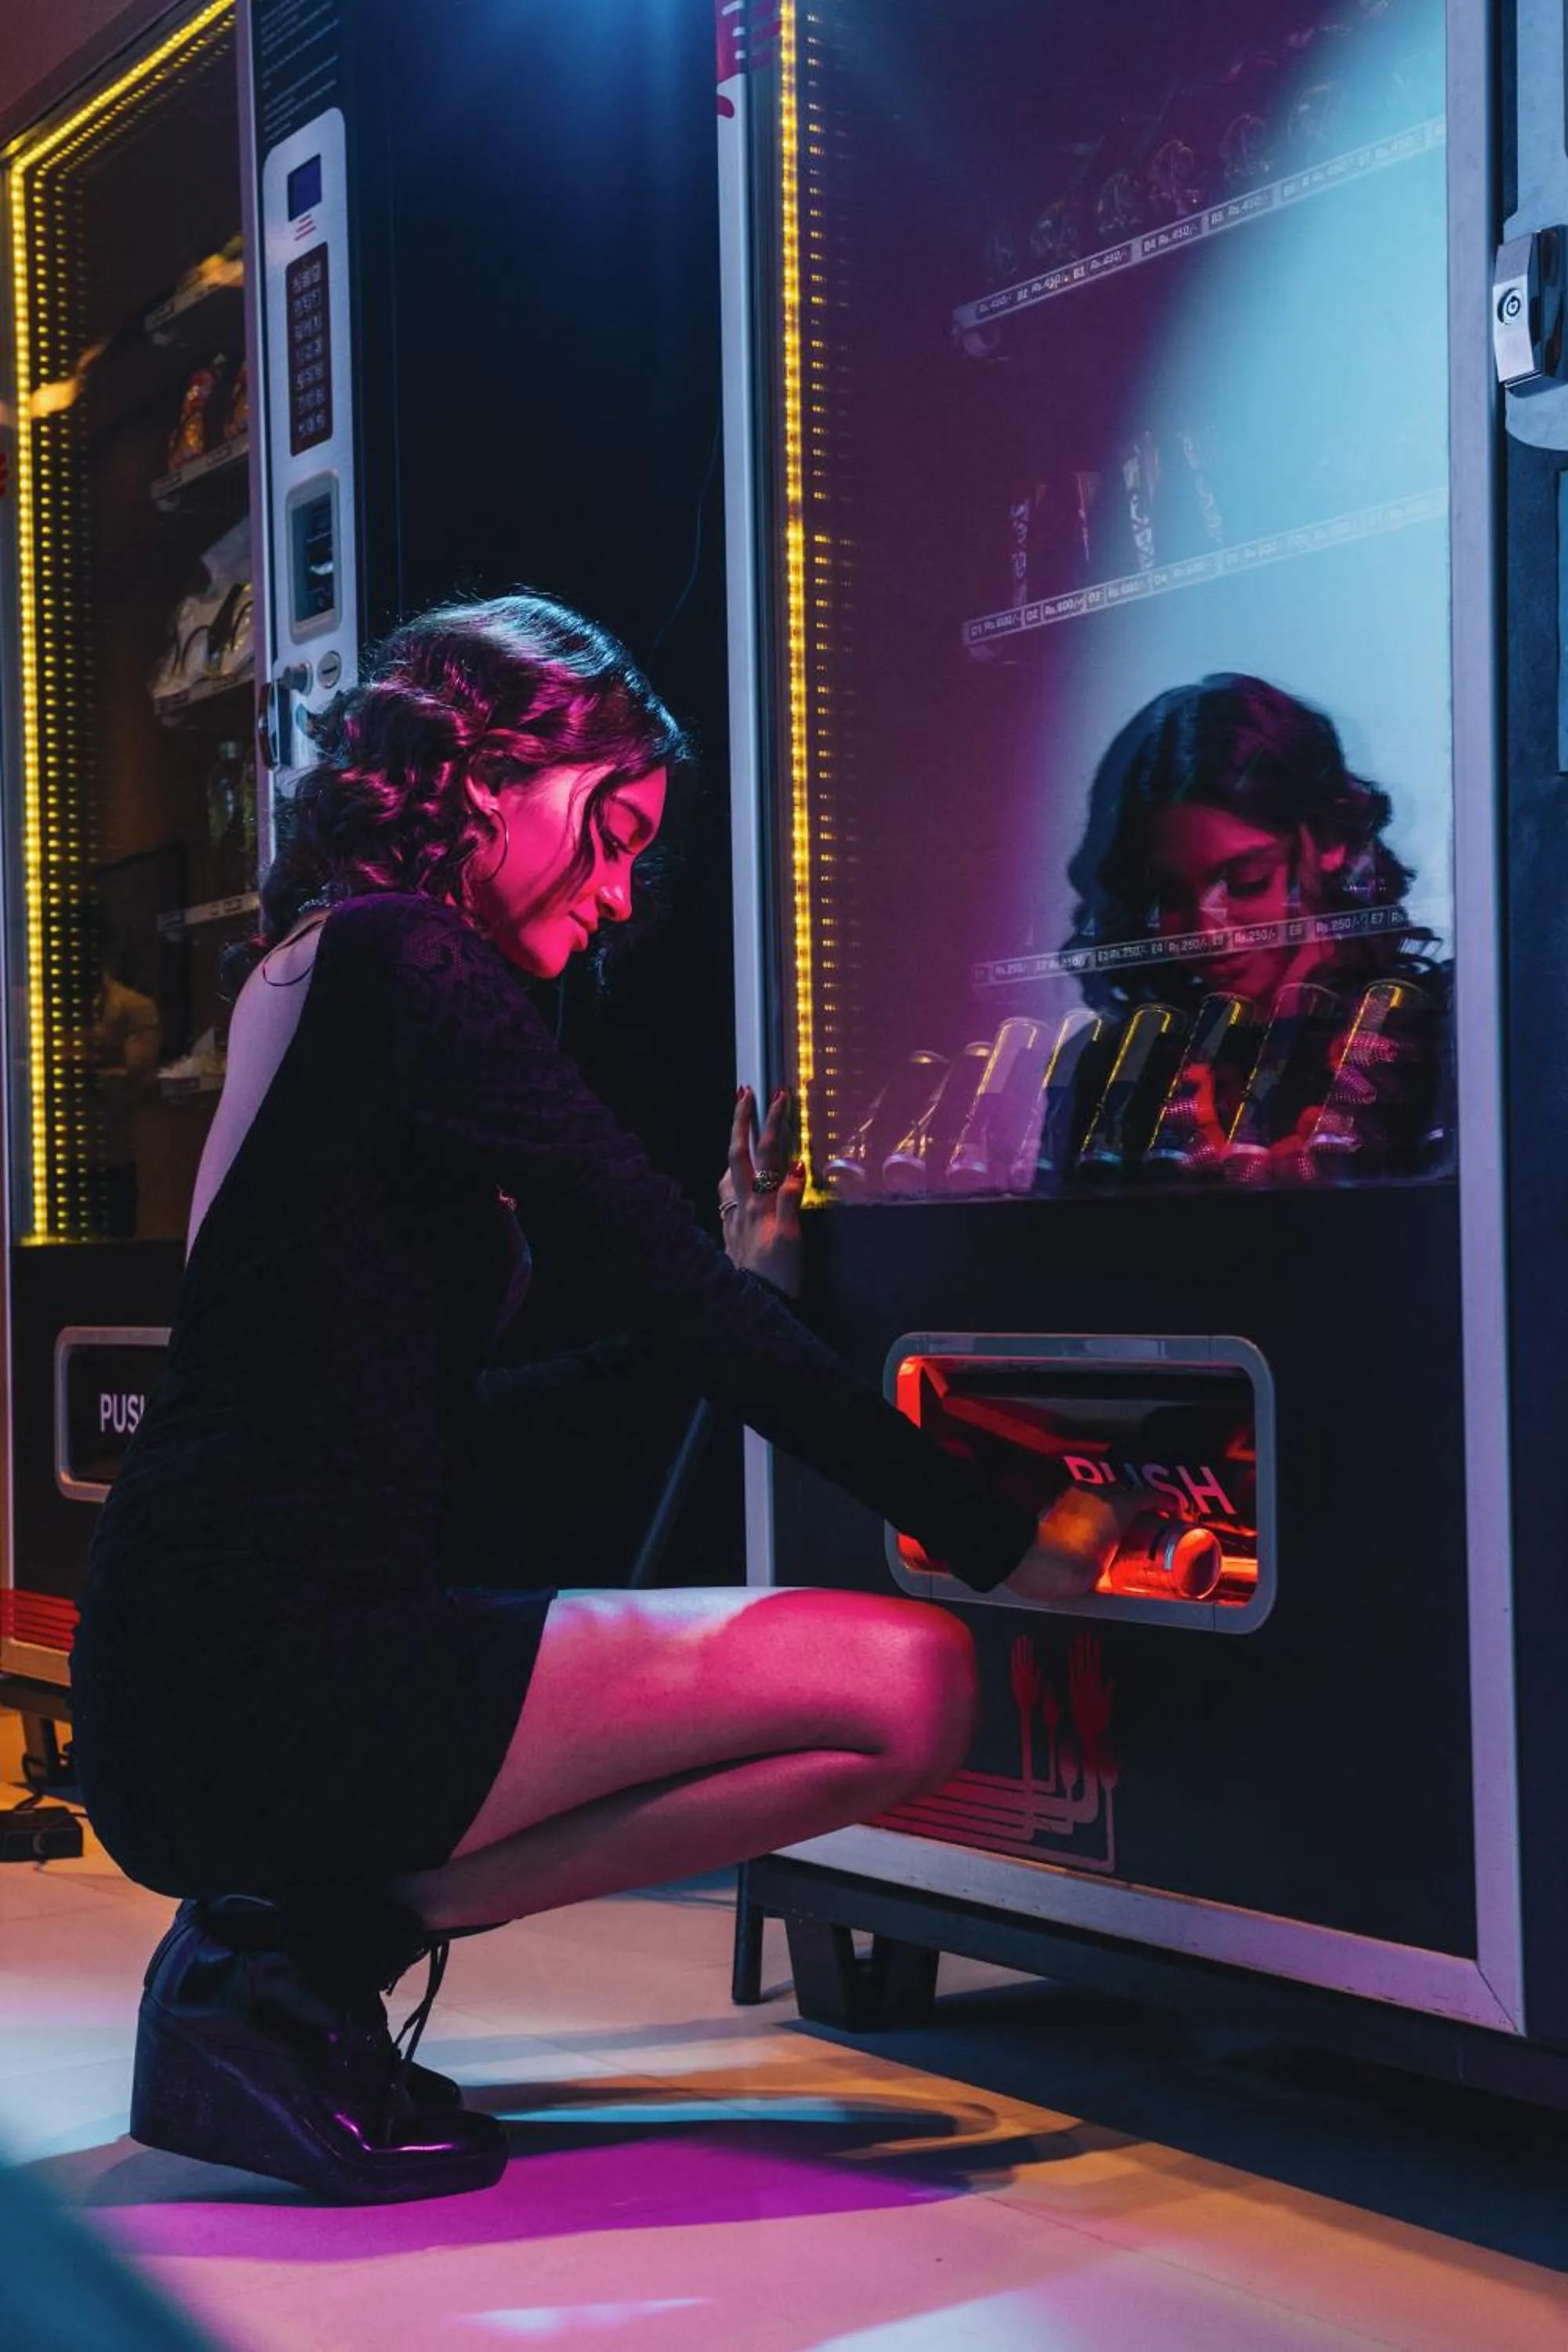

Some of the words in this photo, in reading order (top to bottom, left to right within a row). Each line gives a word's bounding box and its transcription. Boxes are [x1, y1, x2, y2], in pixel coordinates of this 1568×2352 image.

[1151, 943, 1163, 954] E4
[1235, 927, 1276, 944] Rs.250/-
[1316, 916, 1360, 933] Rs.250/-
[1370, 911, 1384, 924] E7
